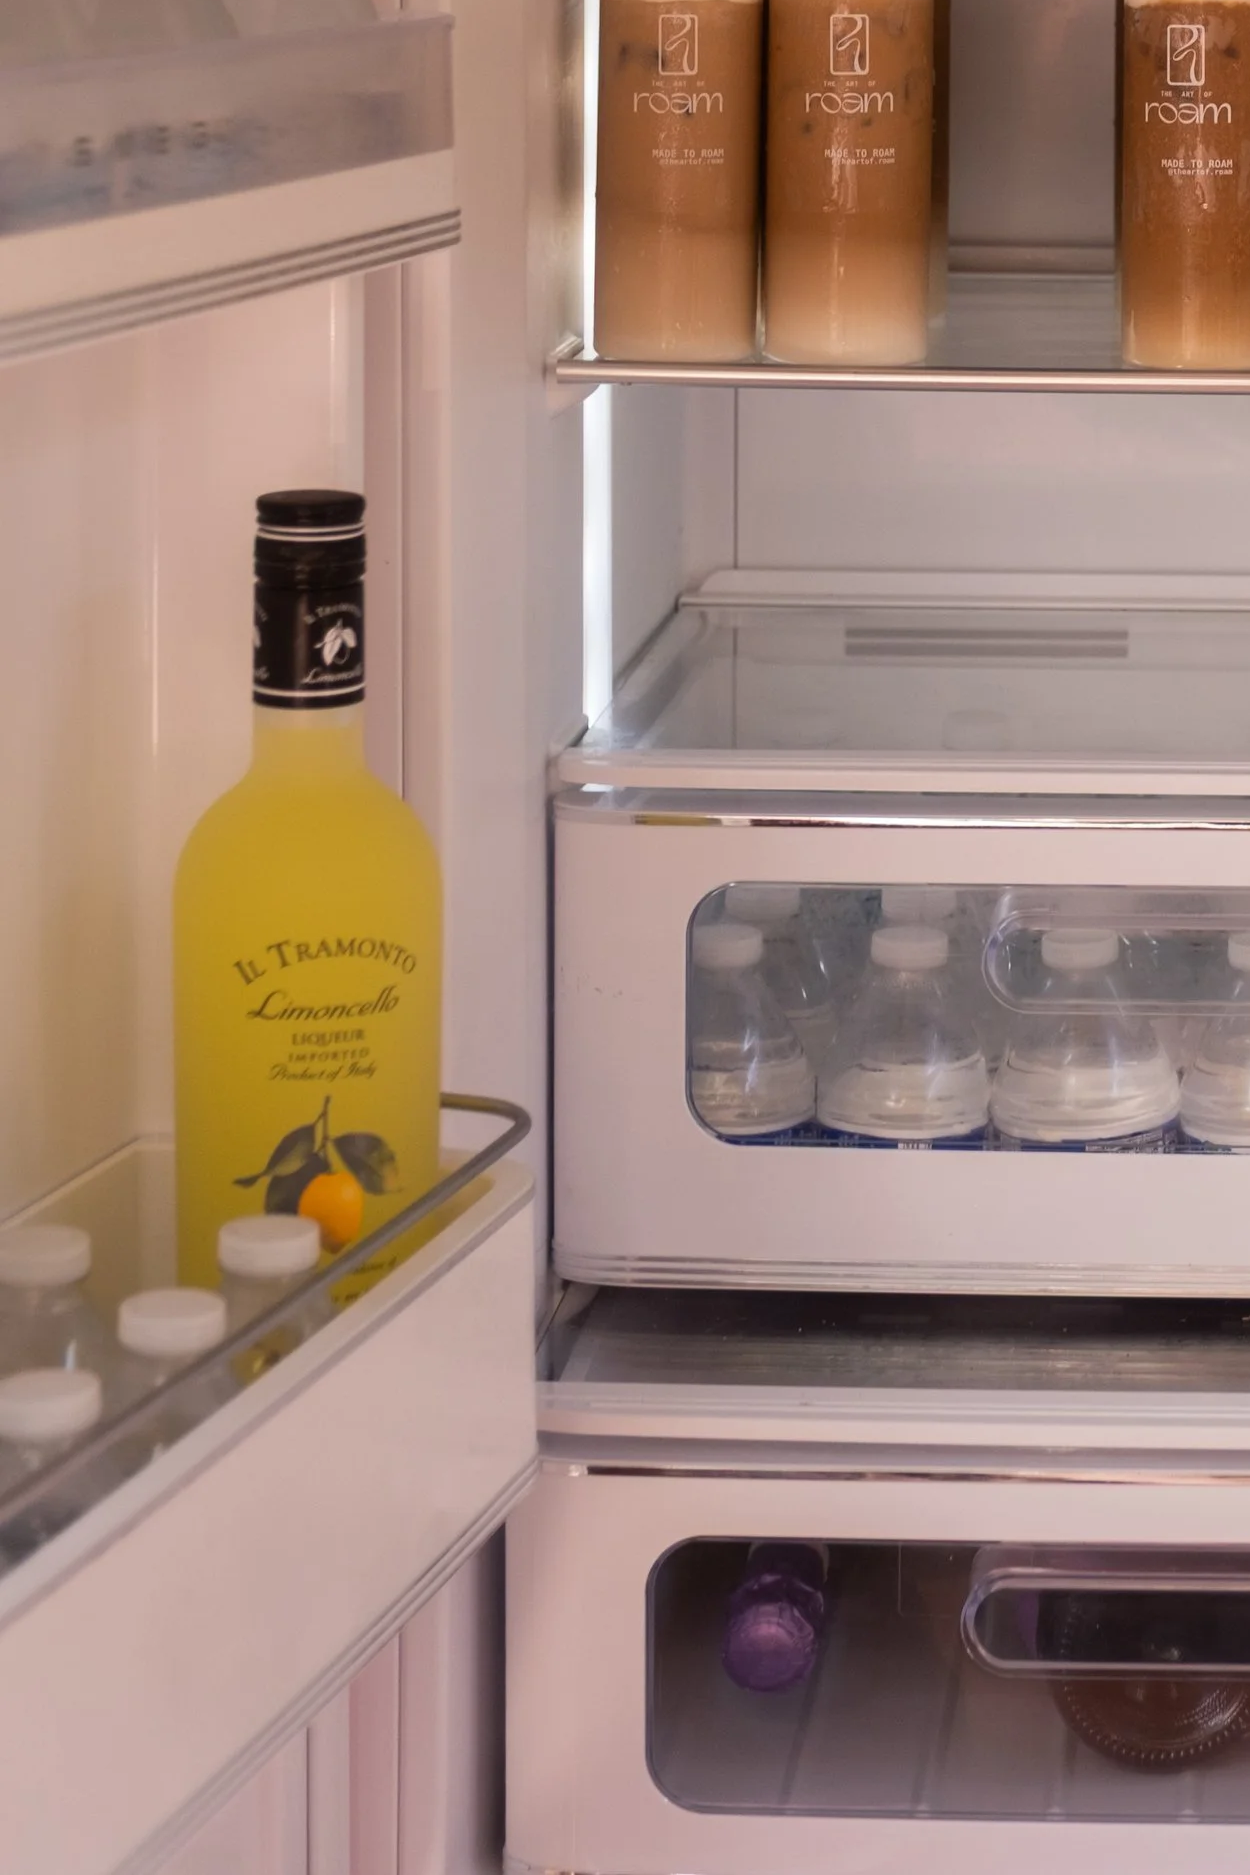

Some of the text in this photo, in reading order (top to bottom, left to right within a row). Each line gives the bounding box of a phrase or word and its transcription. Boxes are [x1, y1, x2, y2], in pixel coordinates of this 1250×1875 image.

[633, 92, 724, 114] roam
[805, 92, 894, 114] roam
[1145, 102, 1232, 124] roam
[652, 148, 724, 158] MADE TO ROAM
[824, 148, 895, 158] MADE TO ROAM
[1161, 159, 1233, 168] MADE TO ROAM
[1168, 167, 1233, 176] @theartof.roam
[232, 937, 417, 986] IL TRAMONTO
[246, 984, 400, 1022] Limoncello
[291, 1028, 366, 1047] LIQUEUR
[287, 1047, 370, 1063] IMPORTED
[268, 1061, 378, 1083] Product of Italy
